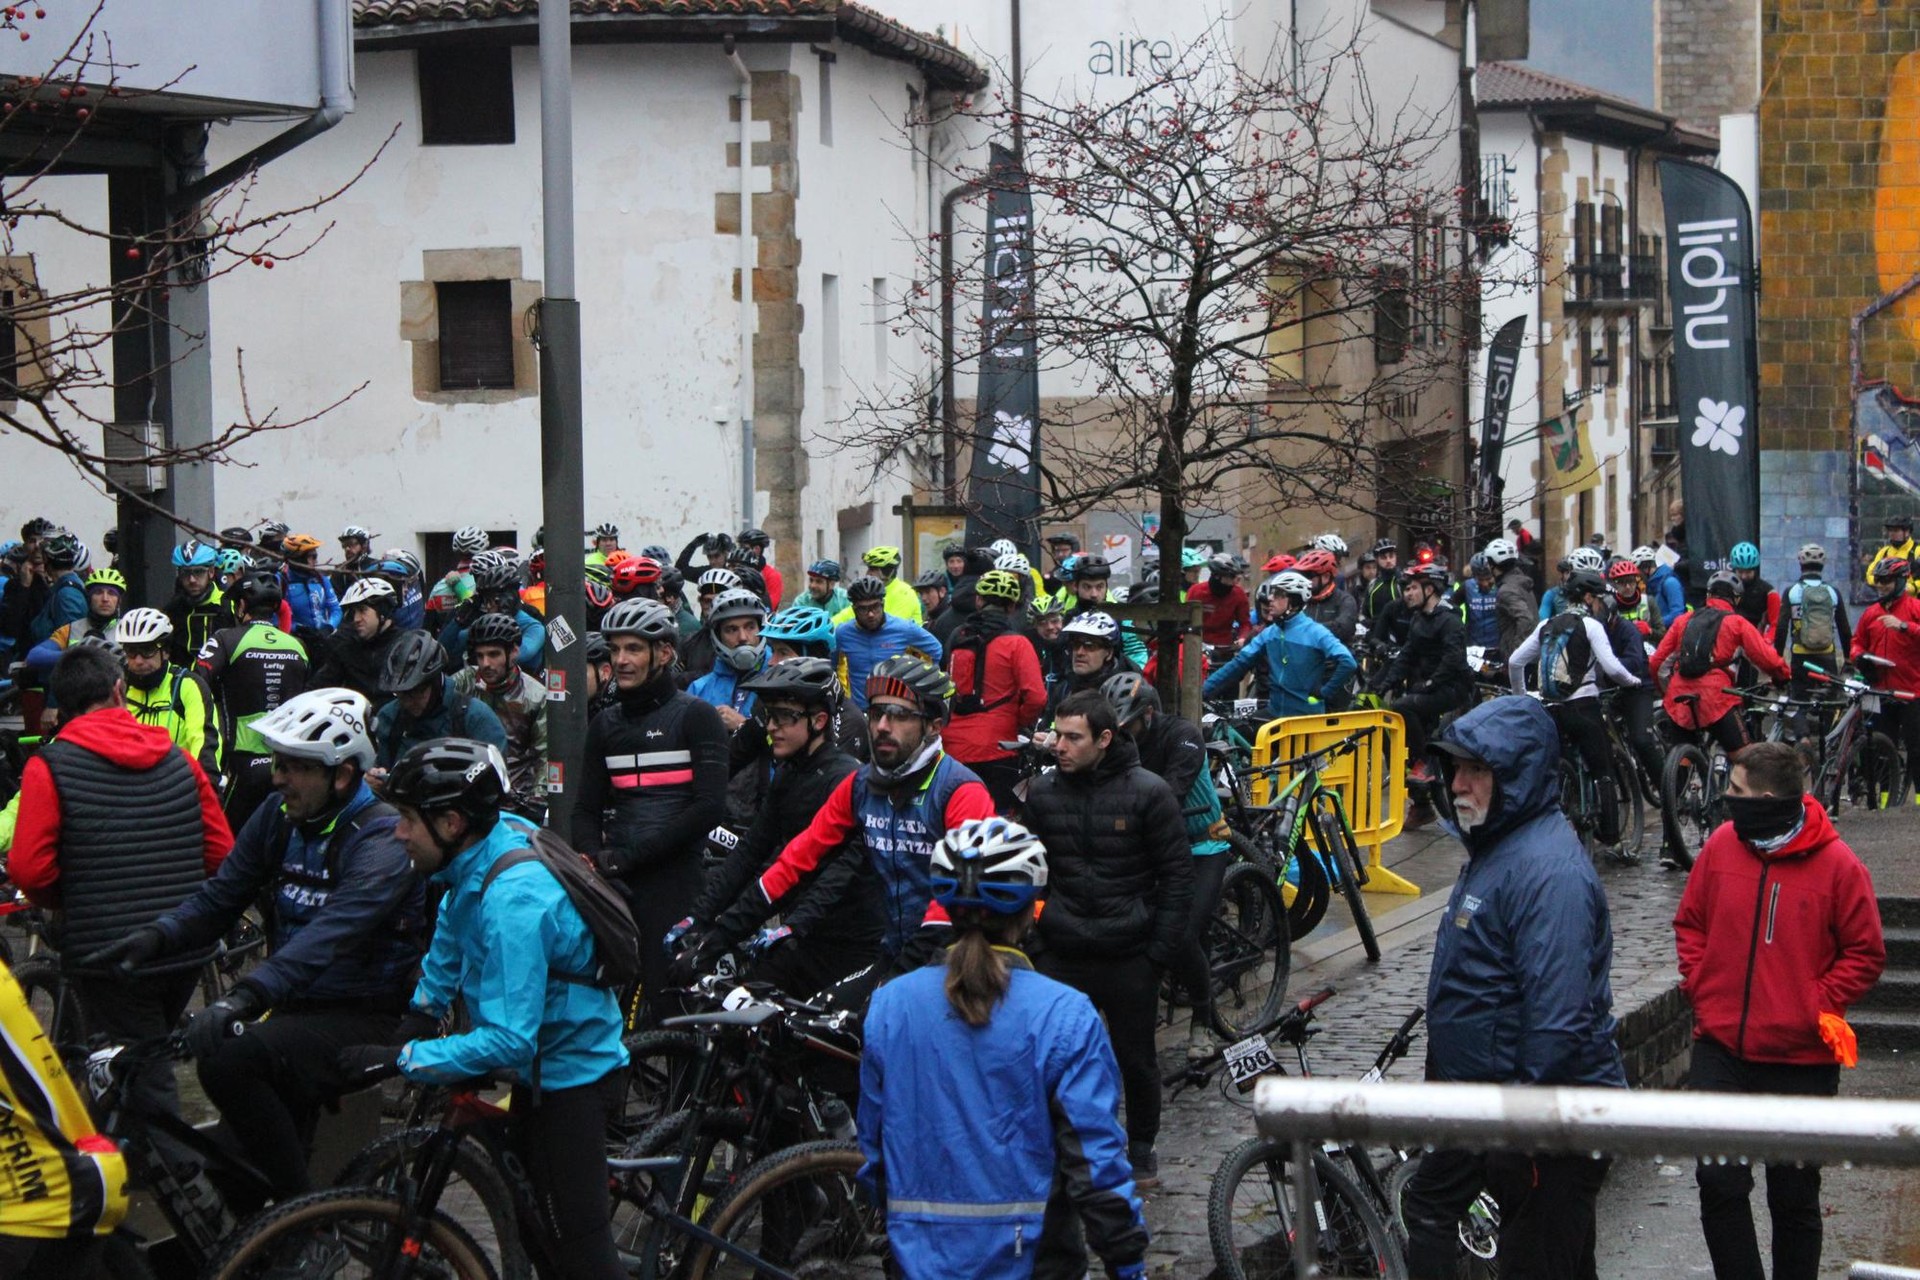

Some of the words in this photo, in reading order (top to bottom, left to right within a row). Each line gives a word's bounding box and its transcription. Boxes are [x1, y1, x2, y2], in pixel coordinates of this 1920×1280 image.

[1088, 32, 1173, 77] aire
[712, 829, 736, 847] 169
[1230, 1046, 1272, 1079] 200
